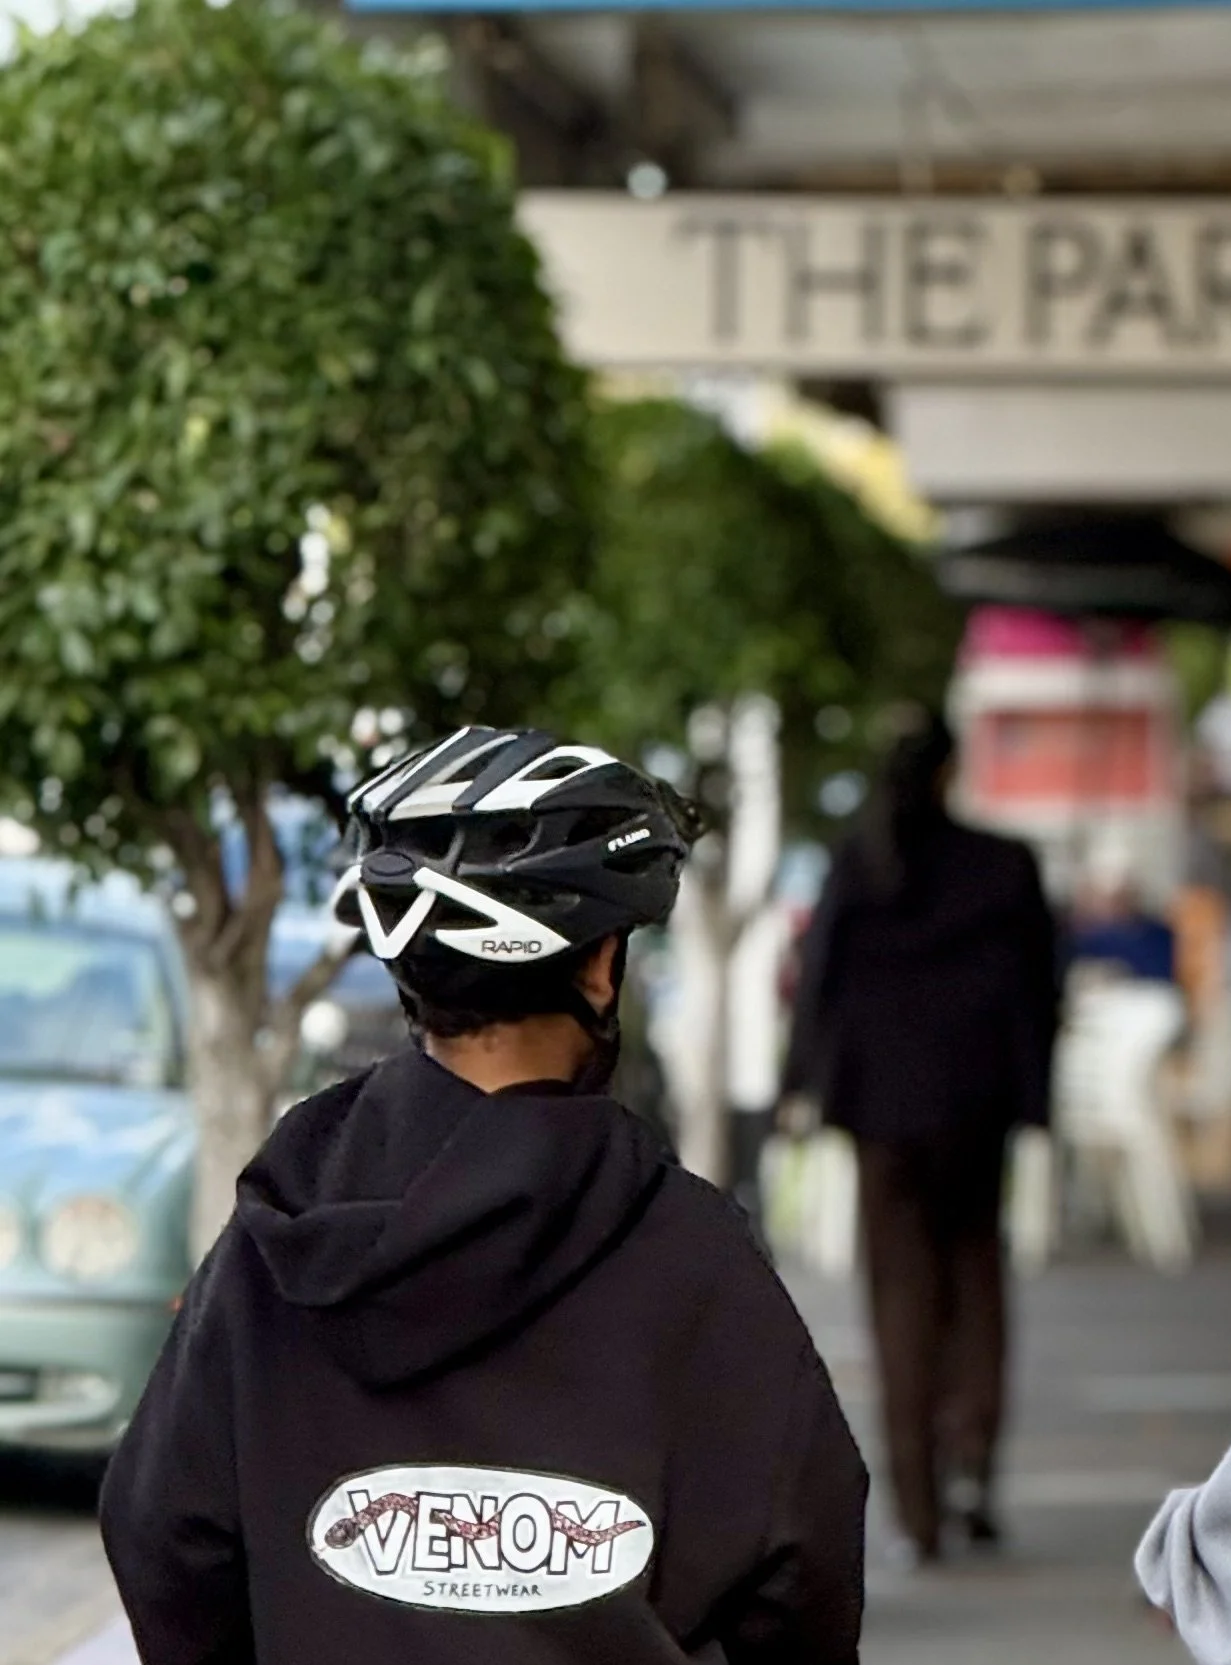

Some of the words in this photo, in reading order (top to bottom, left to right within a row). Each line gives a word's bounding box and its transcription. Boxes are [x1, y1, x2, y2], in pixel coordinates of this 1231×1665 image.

[672, 216, 990, 347] THE
[481, 940, 542, 954] RAPID
[347, 1489, 621, 1575] VENOM
[423, 1580, 543, 1598] STREETWEAR
